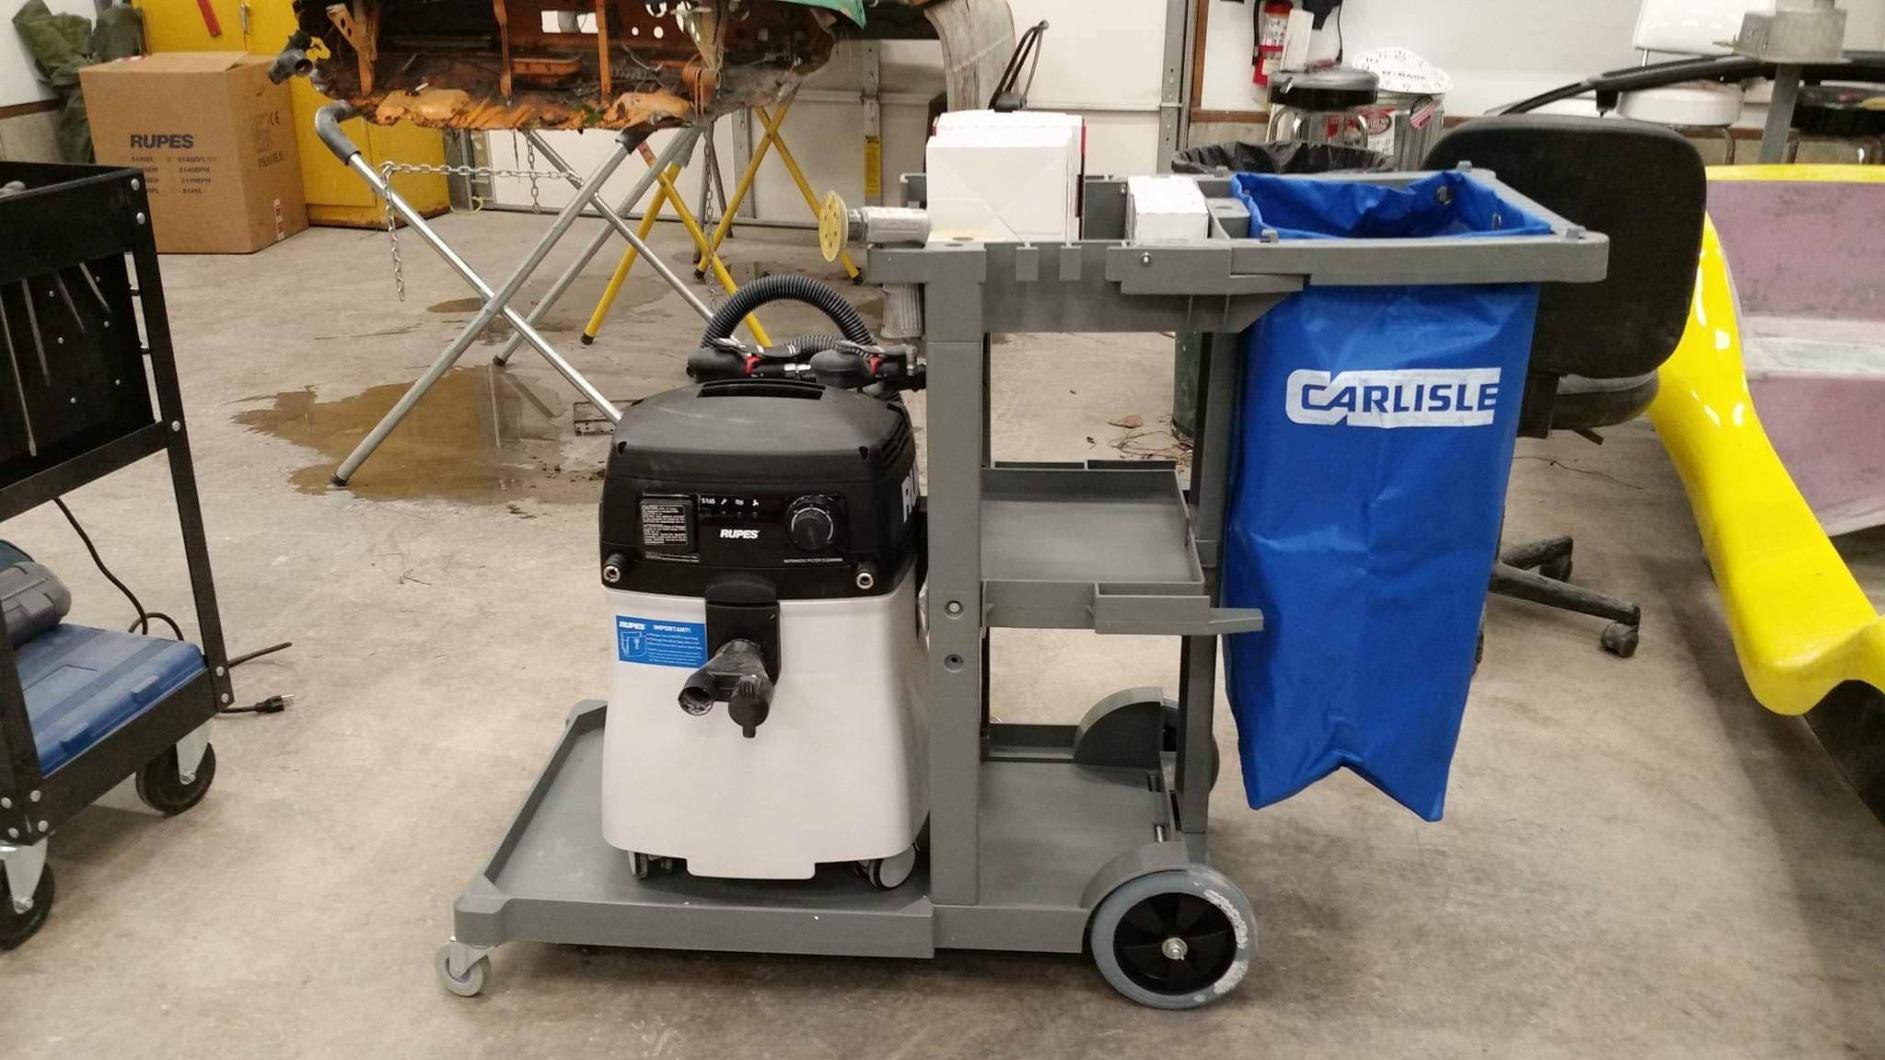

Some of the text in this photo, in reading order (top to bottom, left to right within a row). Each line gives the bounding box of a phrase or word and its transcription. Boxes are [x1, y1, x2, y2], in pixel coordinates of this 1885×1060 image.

[130, 134, 194, 149] RUPES
[1301, 383, 1500, 413] CARLISLE
[720, 529, 759, 539] RUPES
[619, 621, 646, 630] RUPES
